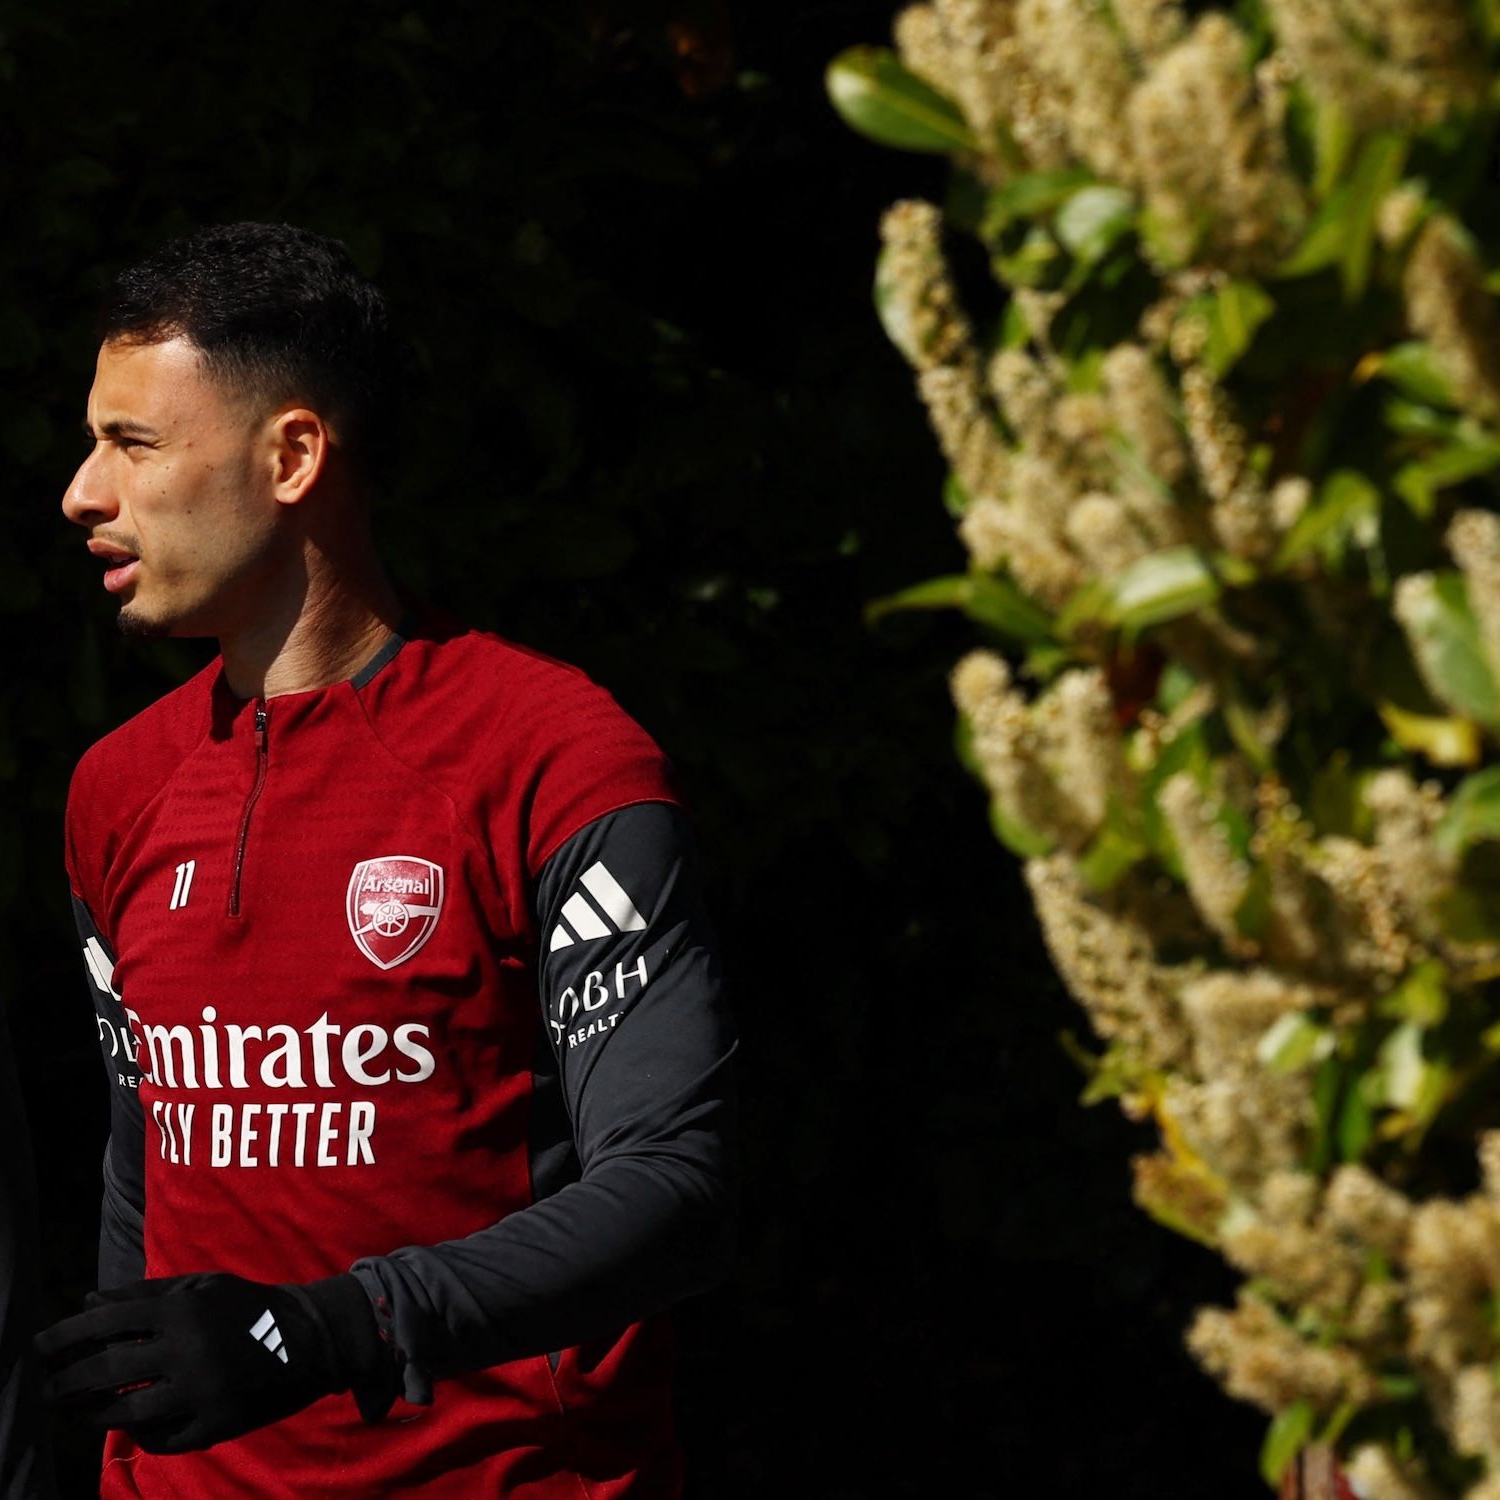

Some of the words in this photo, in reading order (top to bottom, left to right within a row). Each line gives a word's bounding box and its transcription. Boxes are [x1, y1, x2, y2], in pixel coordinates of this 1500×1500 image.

[169, 860, 196, 910] 11
[361, 874, 429, 895] Arsenal
[568, 1011, 624, 1048] REALT
[211, 1101, 376, 1168] BETTER
